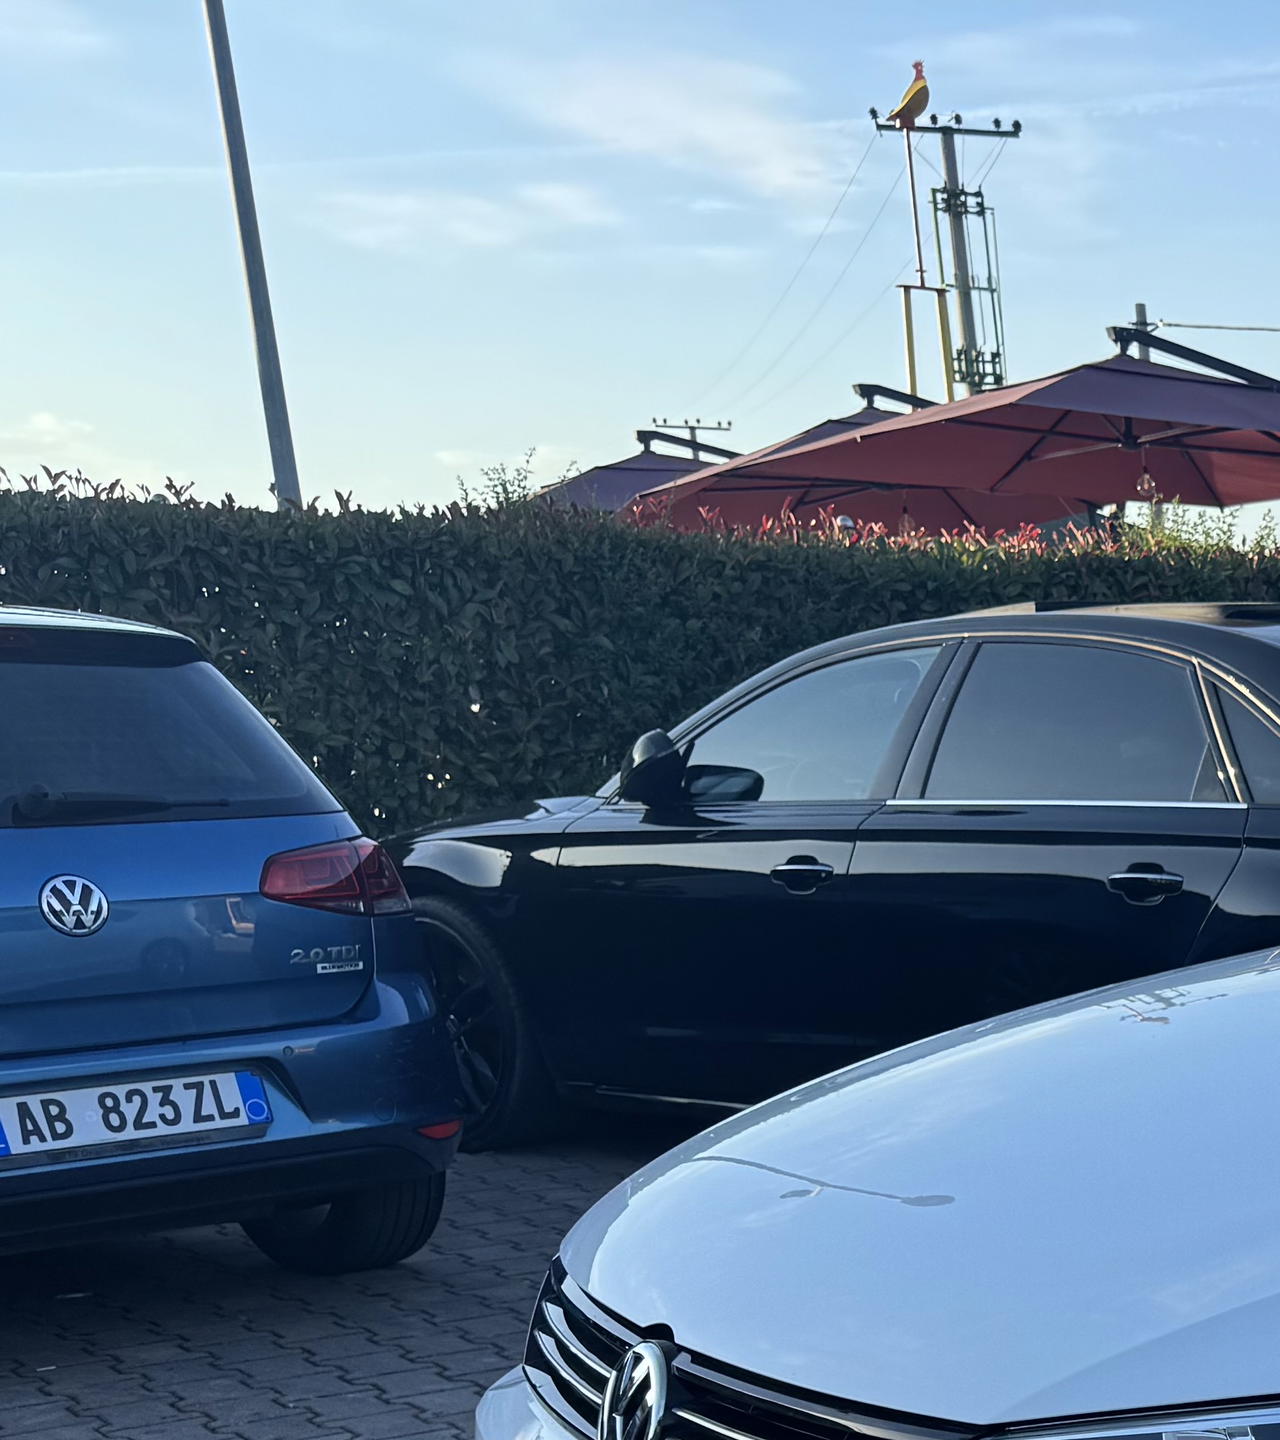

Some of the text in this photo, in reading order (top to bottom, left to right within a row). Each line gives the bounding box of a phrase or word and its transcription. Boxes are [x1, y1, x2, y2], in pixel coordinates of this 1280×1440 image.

[327, 944, 361, 960] TDI
[16, 1079, 241, 1146] AB 823 ZL
